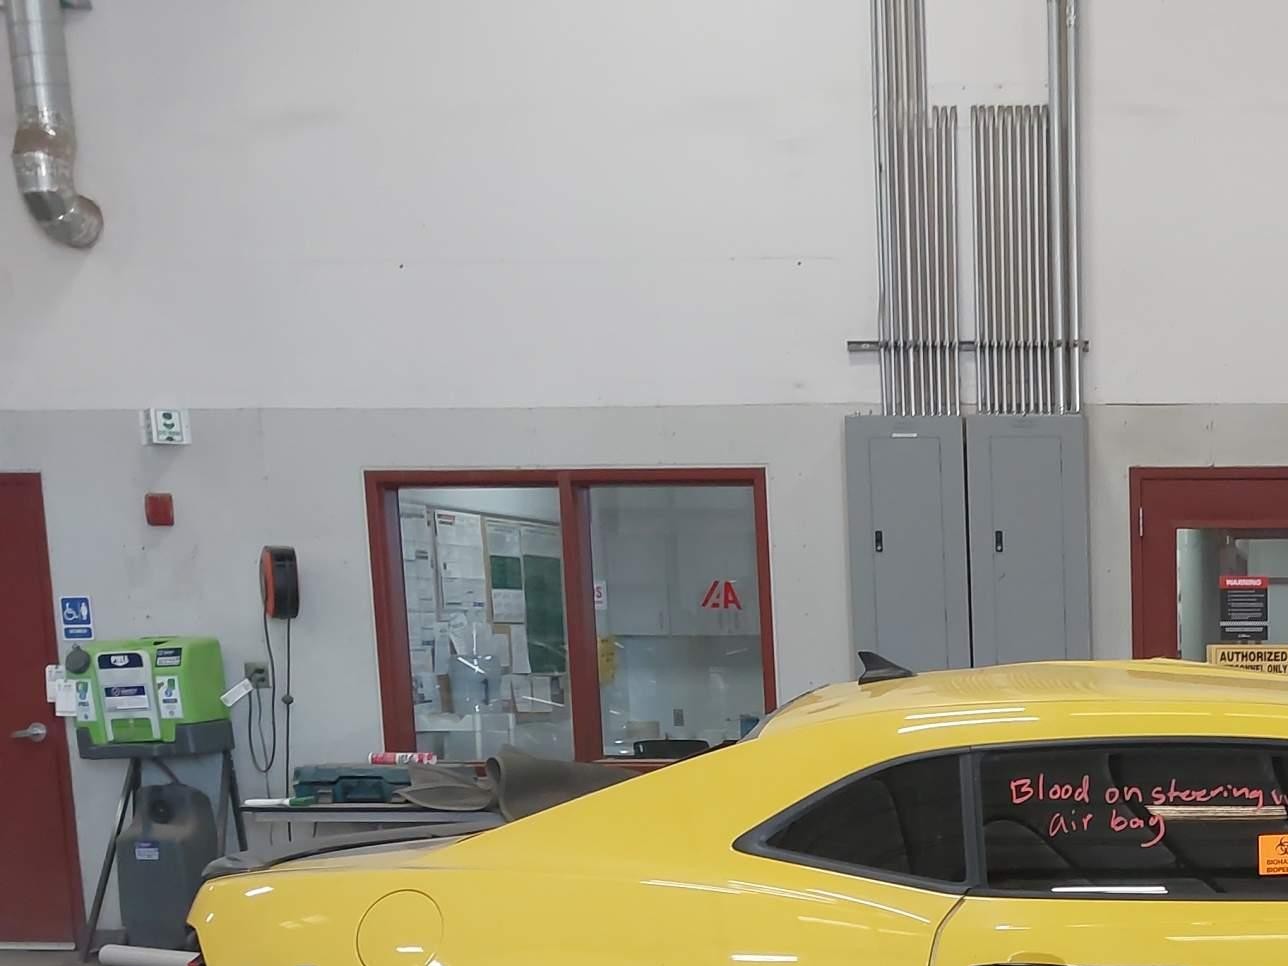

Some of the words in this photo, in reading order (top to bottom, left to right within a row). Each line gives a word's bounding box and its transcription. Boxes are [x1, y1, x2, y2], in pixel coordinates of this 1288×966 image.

[1220, 651, 1288, 662] AUTHORIZED
[1267, 664, 1288, 673] ONLY
[1010, 773, 1089, 804] Blood
[1105, 787, 1142, 804] on
[1049, 810, 1094, 836] air
[1110, 809, 1165, 848] bag
